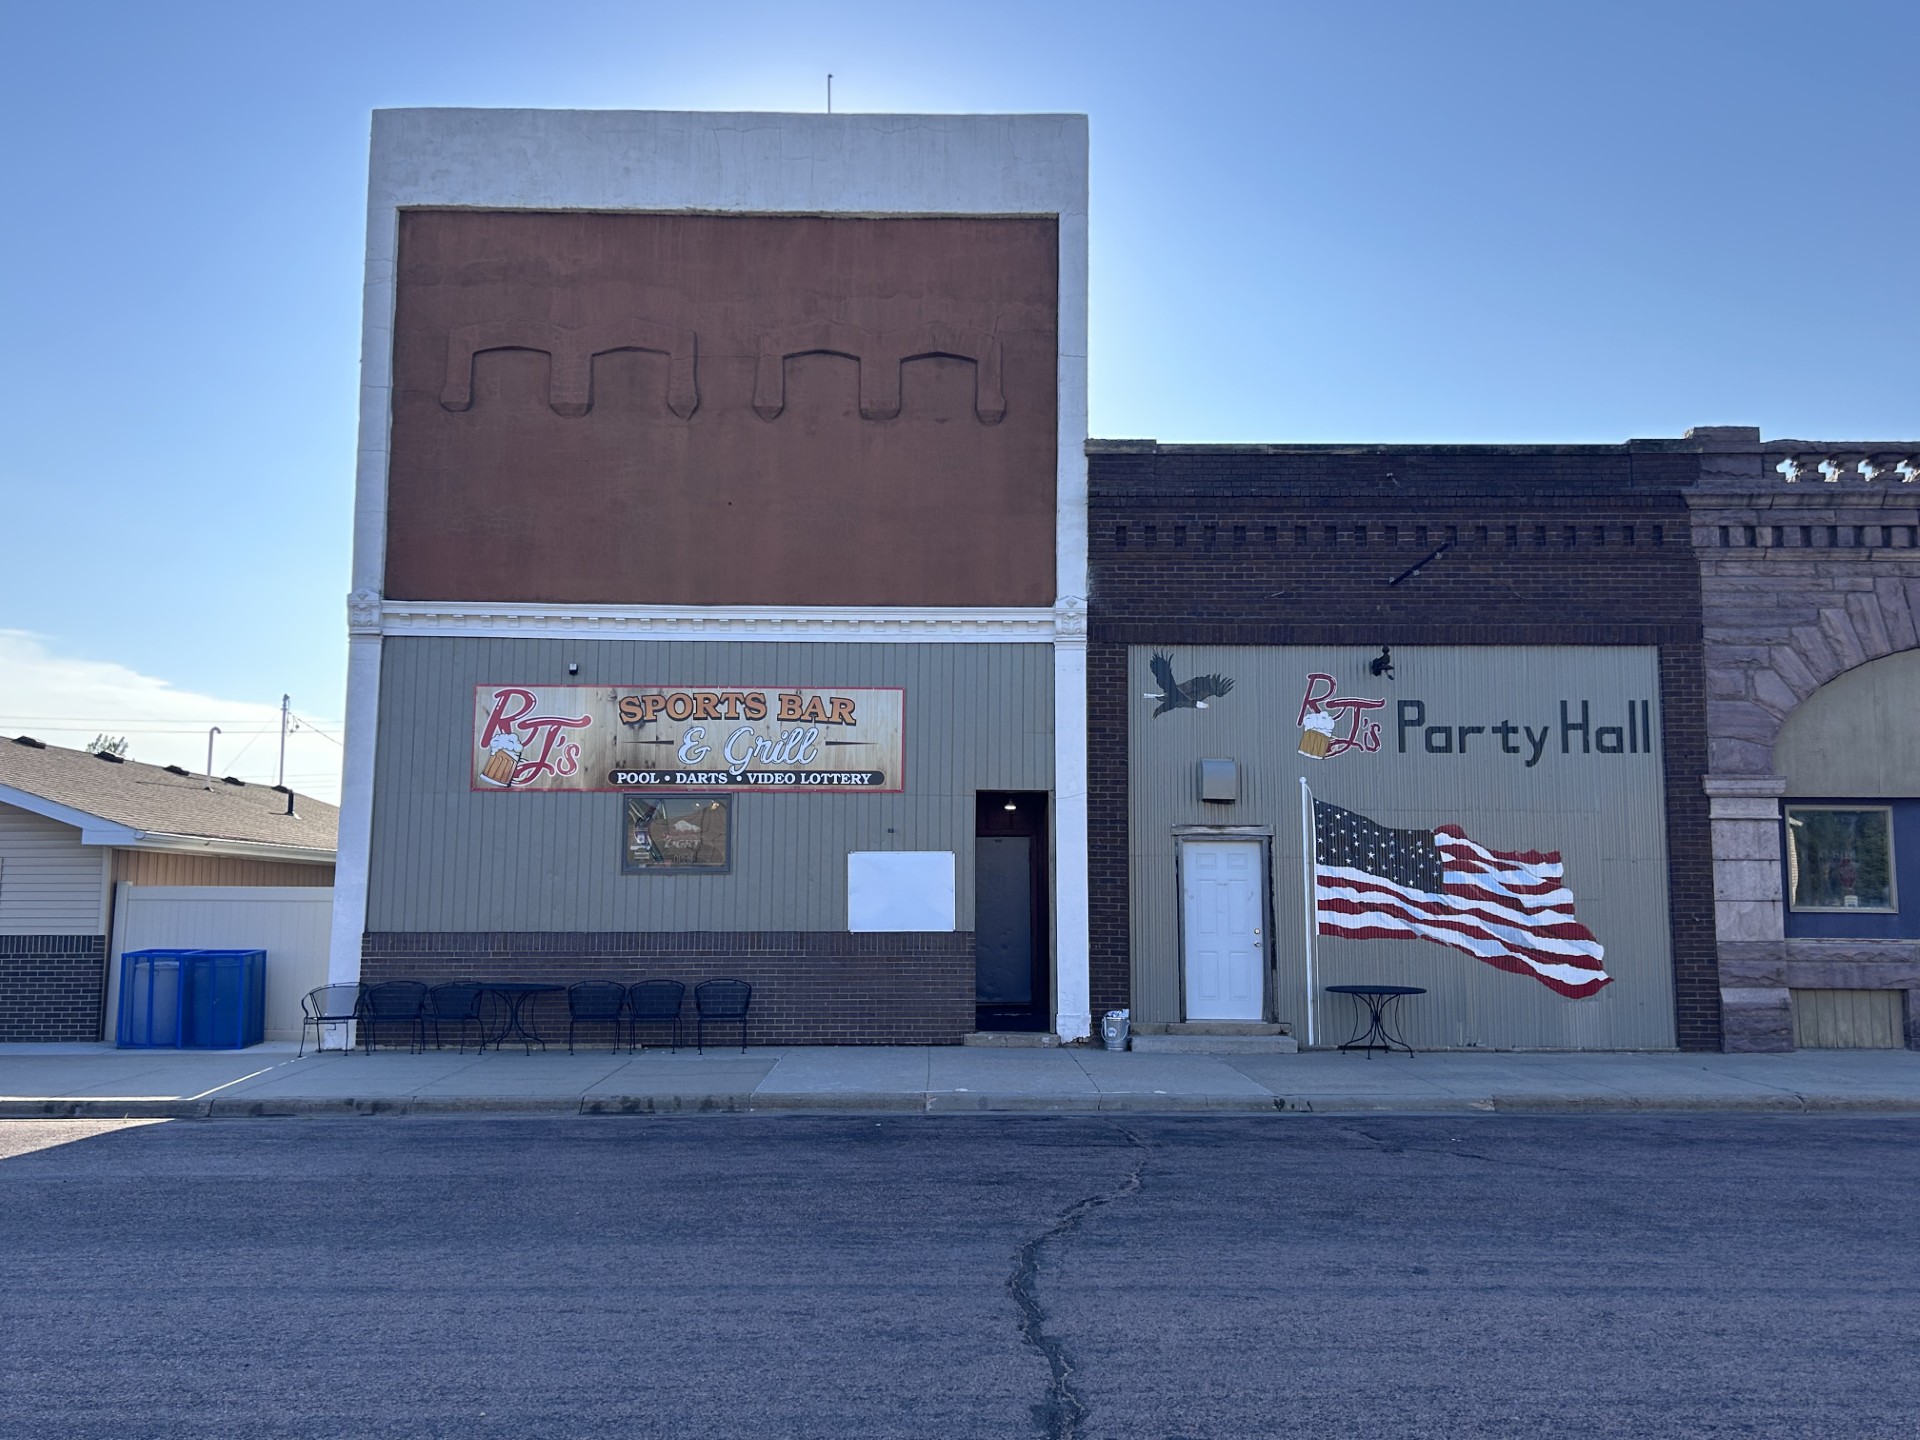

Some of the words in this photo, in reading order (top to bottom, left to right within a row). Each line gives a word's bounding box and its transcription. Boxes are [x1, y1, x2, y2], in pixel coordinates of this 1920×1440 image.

[619, 692, 767, 725] SPORTS
[777, 694, 856, 726] BAR
[677, 726, 711, 765] &
[724, 726, 819, 775] Grill
[1397, 700, 1549, 768] Party
[1559, 700, 1651, 754] Hall
[616, 772, 660, 784] POOL
[675, 772, 728, 785] DARTS
[746, 772, 796, 785] VIDEO
[800, 772, 872, 785] LOTTERY
